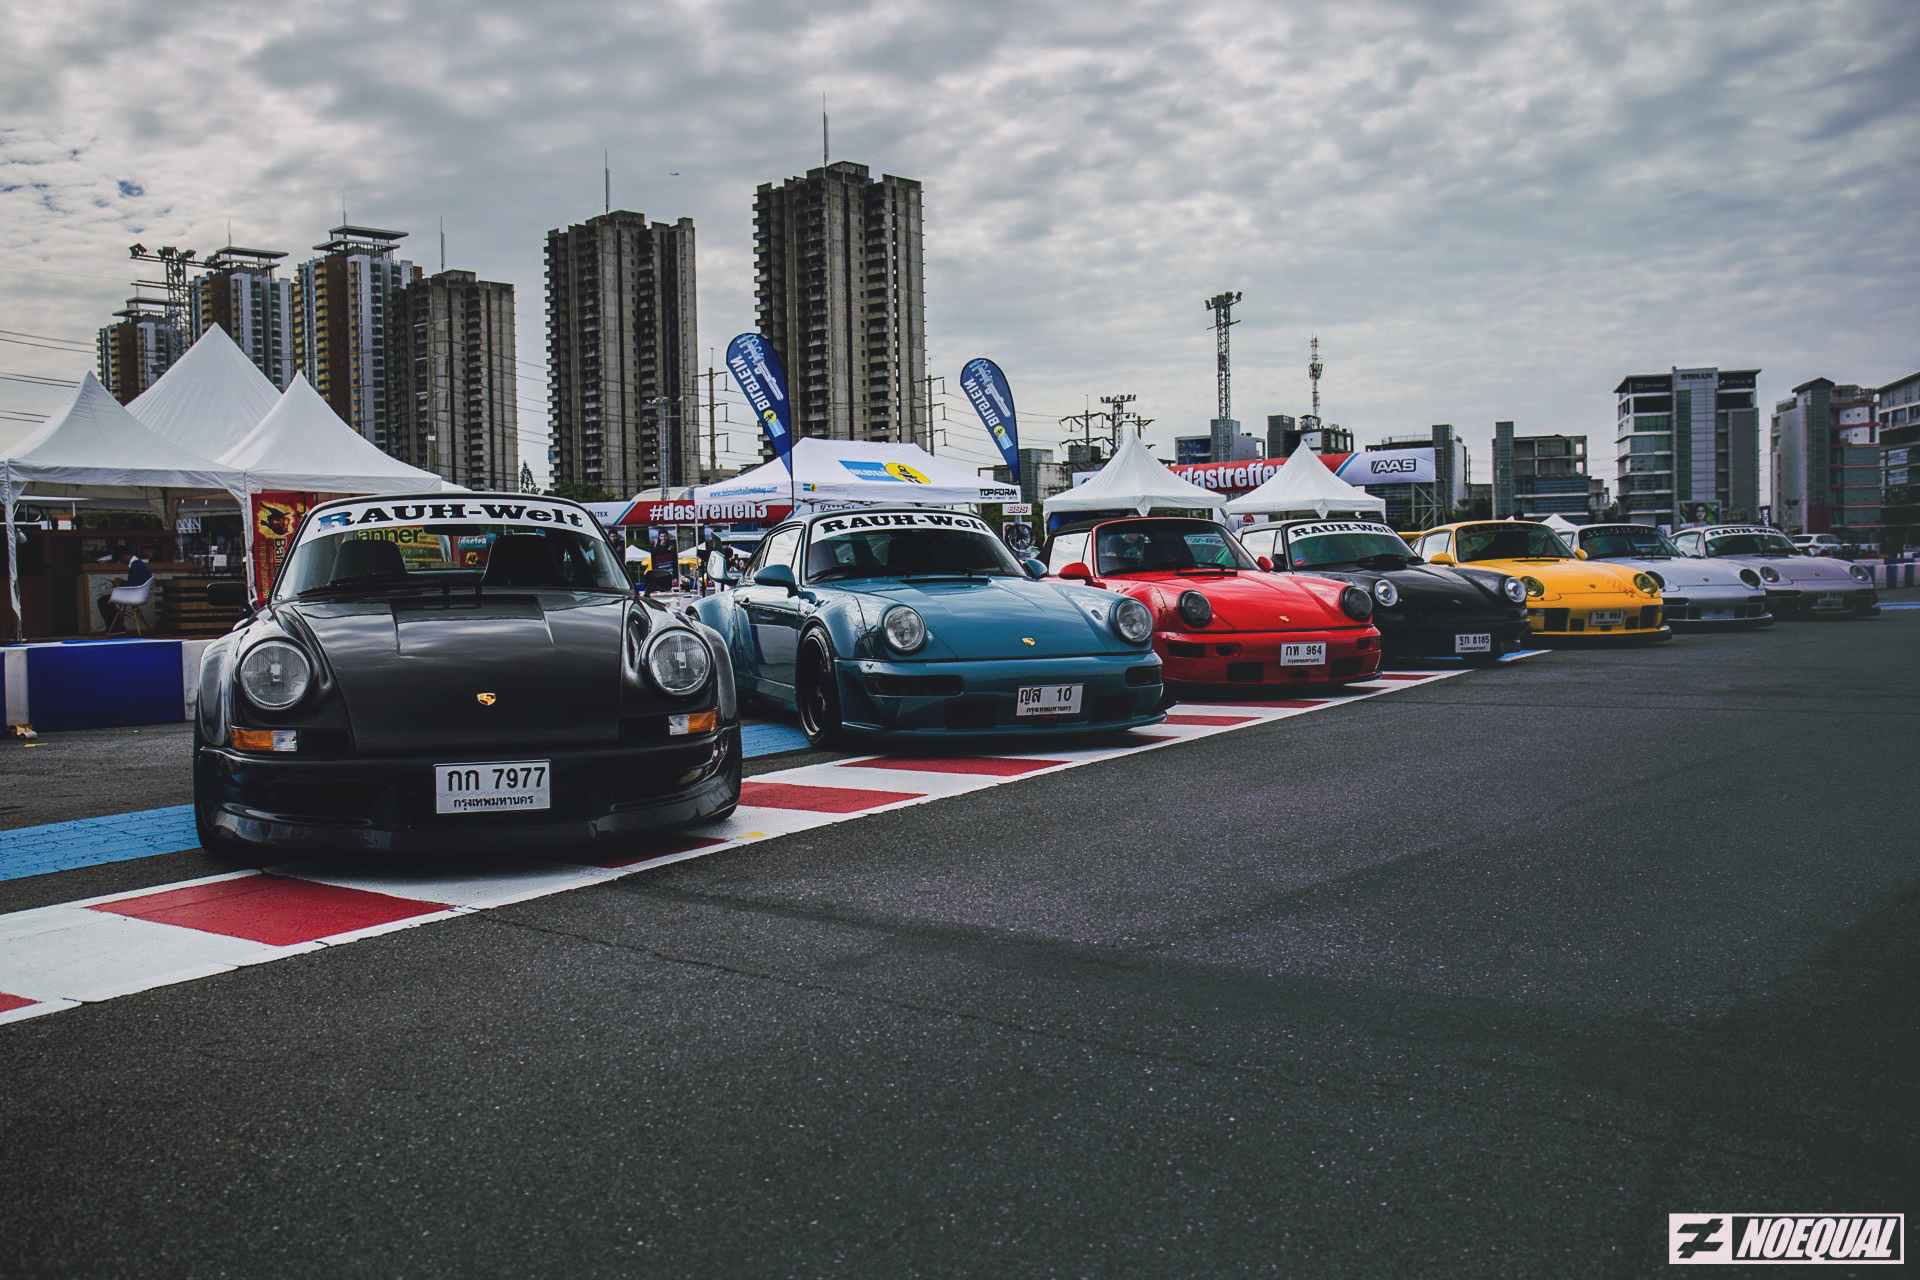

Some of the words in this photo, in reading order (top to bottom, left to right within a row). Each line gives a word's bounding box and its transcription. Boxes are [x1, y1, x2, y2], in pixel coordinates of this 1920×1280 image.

[1372, 459, 1416, 474] AAS
[317, 504, 584, 532] RAUH-Welt
[820, 514, 991, 534] RAUH-Welt
[357, 527, 424, 544] anner
[1306, 645, 1322, 656] 964
[1056, 686, 1073, 702] 10
[447, 769, 480, 791] กก
[492, 766, 546, 790] 7977
[453, 795, 534, 811] กรุงเทพมหานคร
